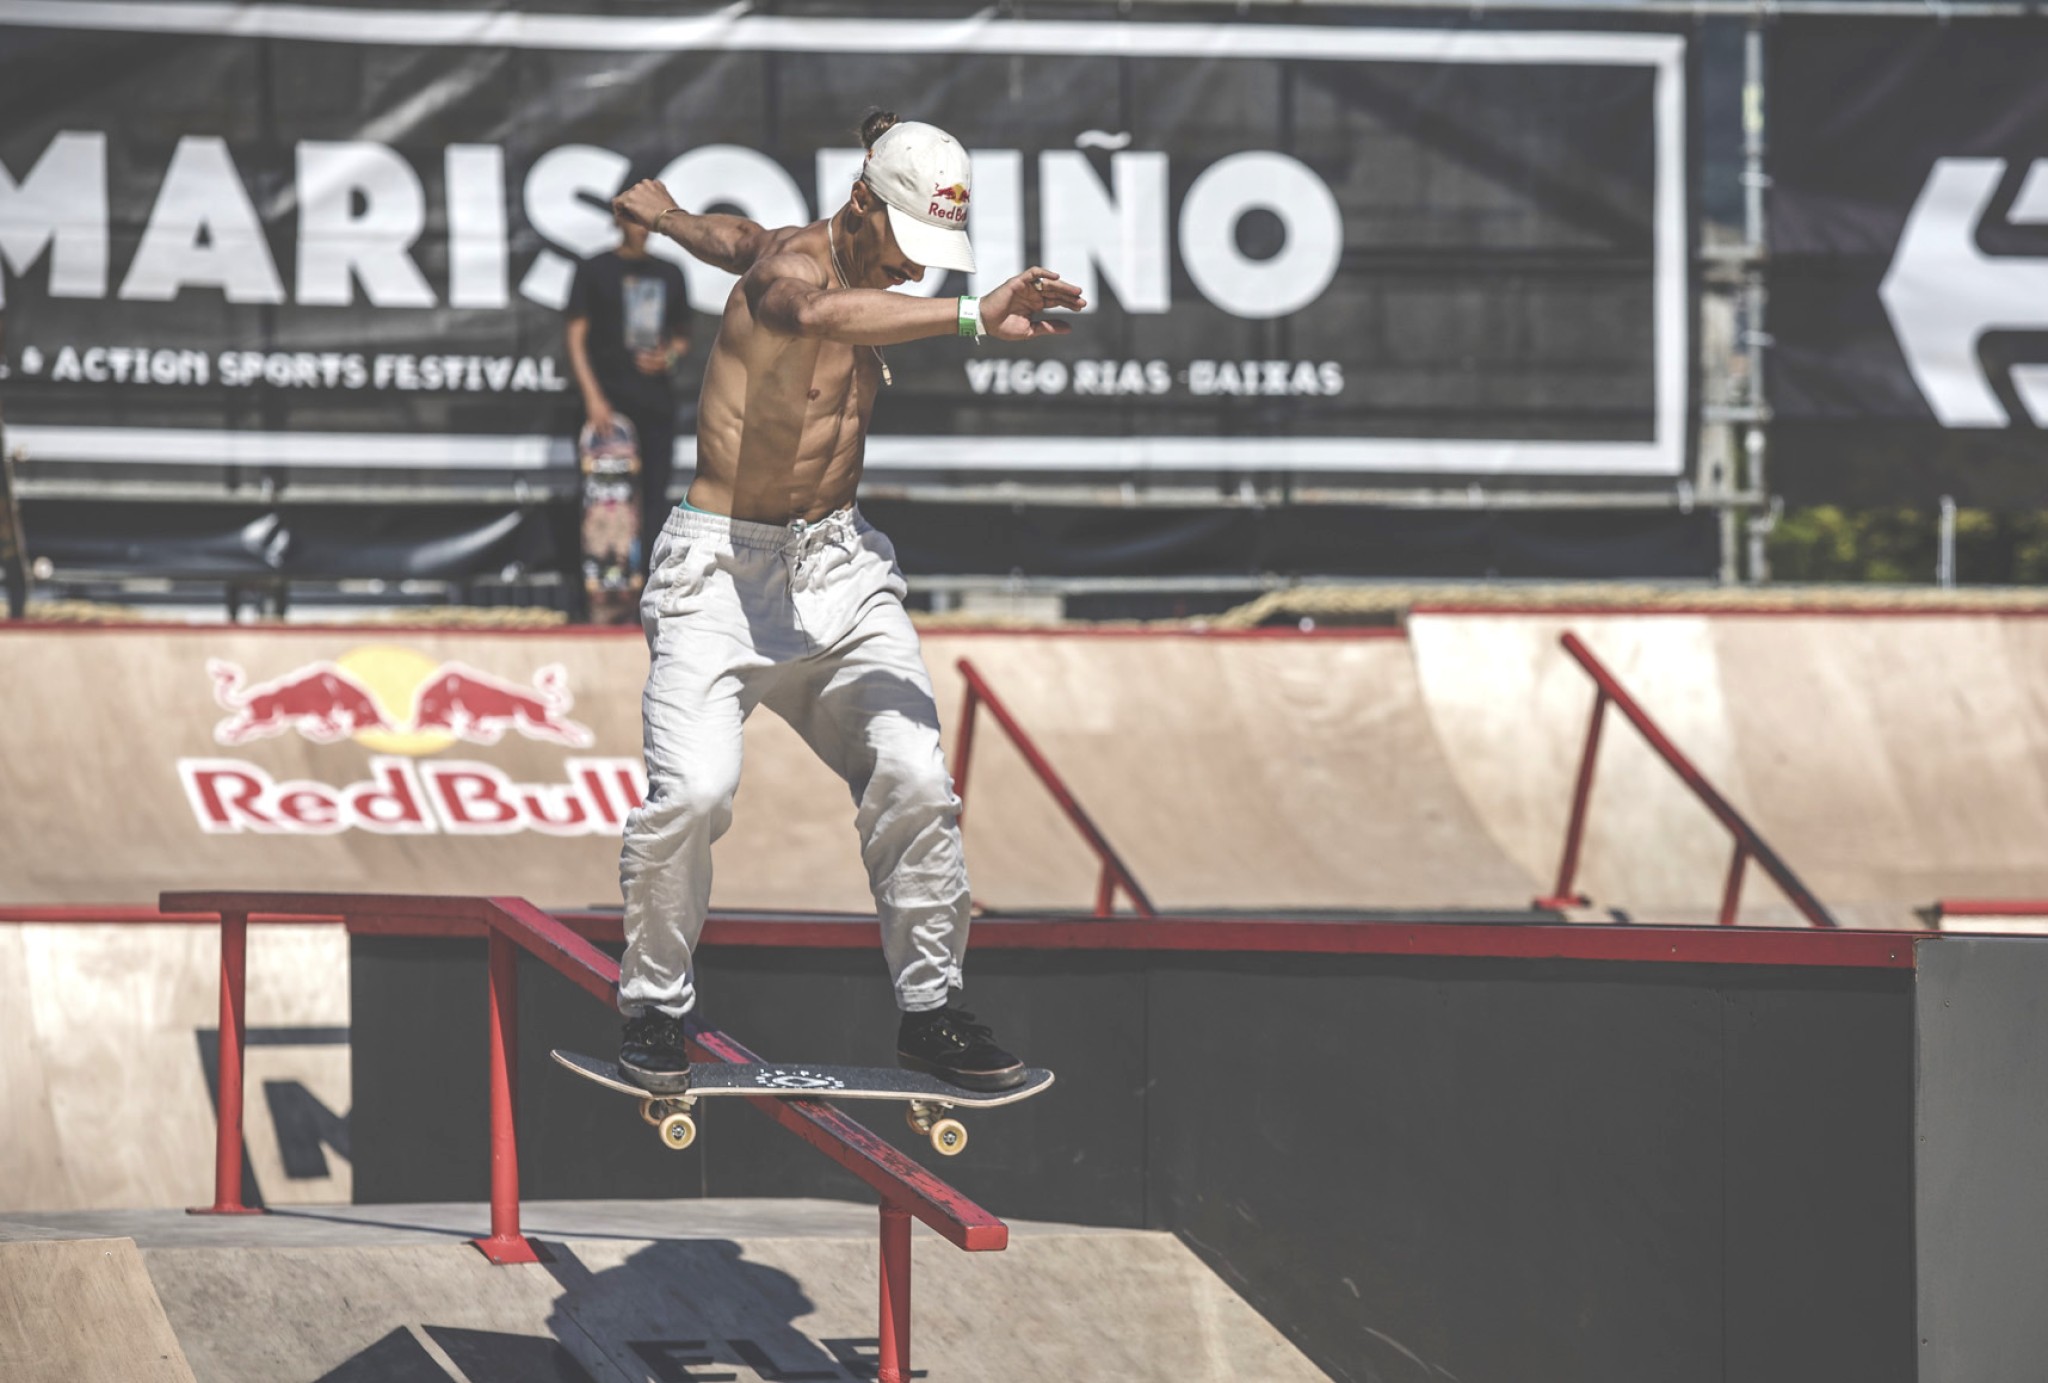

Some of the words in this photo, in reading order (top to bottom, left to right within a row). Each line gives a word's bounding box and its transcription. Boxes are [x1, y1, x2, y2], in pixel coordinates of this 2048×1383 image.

[0, 128, 1344, 320] MARISIÑO
[51, 345, 210, 386] ACTION
[217, 350, 368, 389] SPORTS
[373, 353, 569, 392] FESTIVAL
[964, 358, 1068, 396] VIGO
[1073, 359, 1172, 396] RIAS
[186, 761, 429, 829] Red
